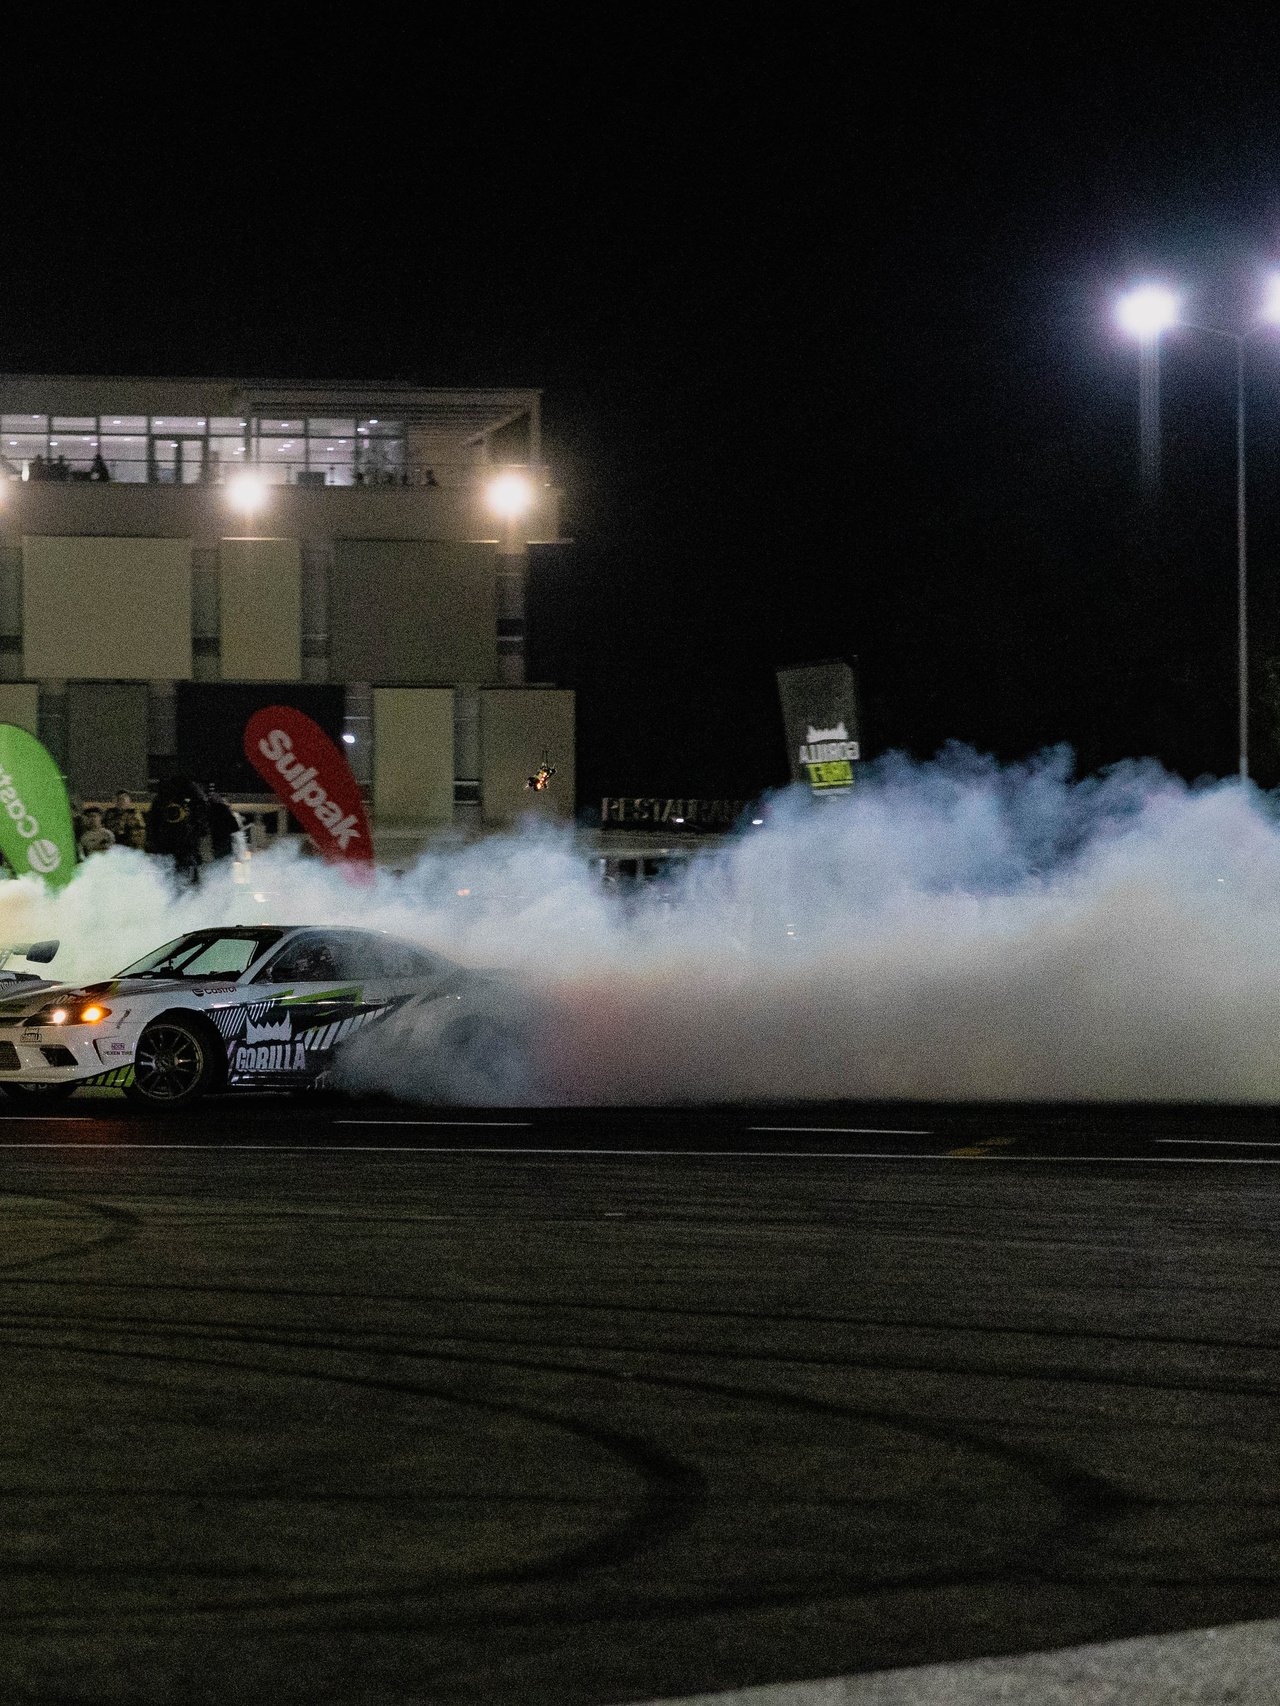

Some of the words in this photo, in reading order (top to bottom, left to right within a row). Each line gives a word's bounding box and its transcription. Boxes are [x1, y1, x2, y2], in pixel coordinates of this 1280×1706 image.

[259, 729, 361, 850] Sulpak
[204, 986, 237, 995] Castrol
[235, 1042, 306, 1073] GORILLA
